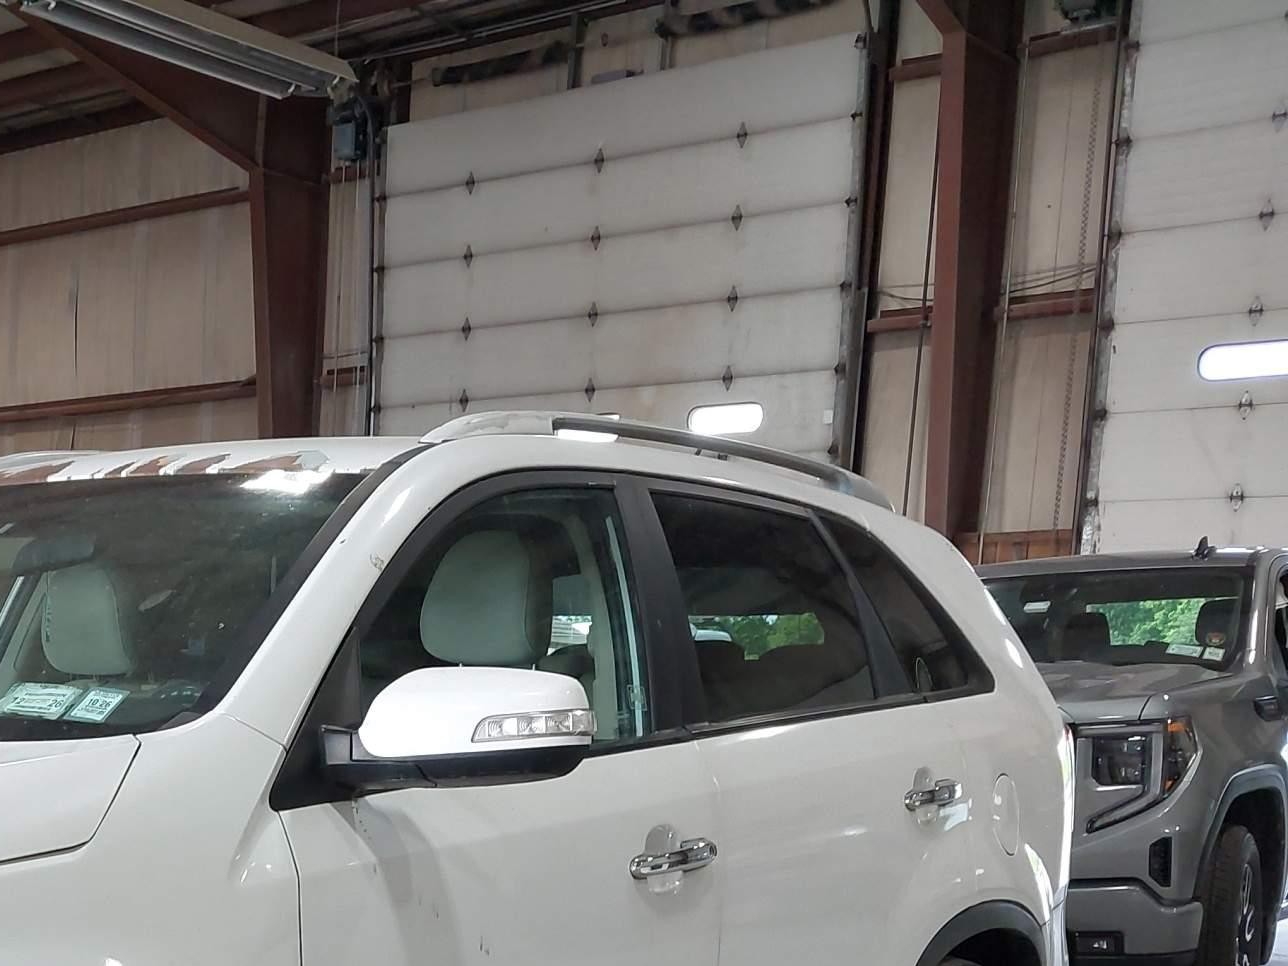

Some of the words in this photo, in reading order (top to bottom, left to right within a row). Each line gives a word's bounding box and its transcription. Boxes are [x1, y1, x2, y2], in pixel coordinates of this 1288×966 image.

[48, 699, 65, 708] 26
[88, 698, 100, 706] 10
[99, 700, 113, 708] 26
